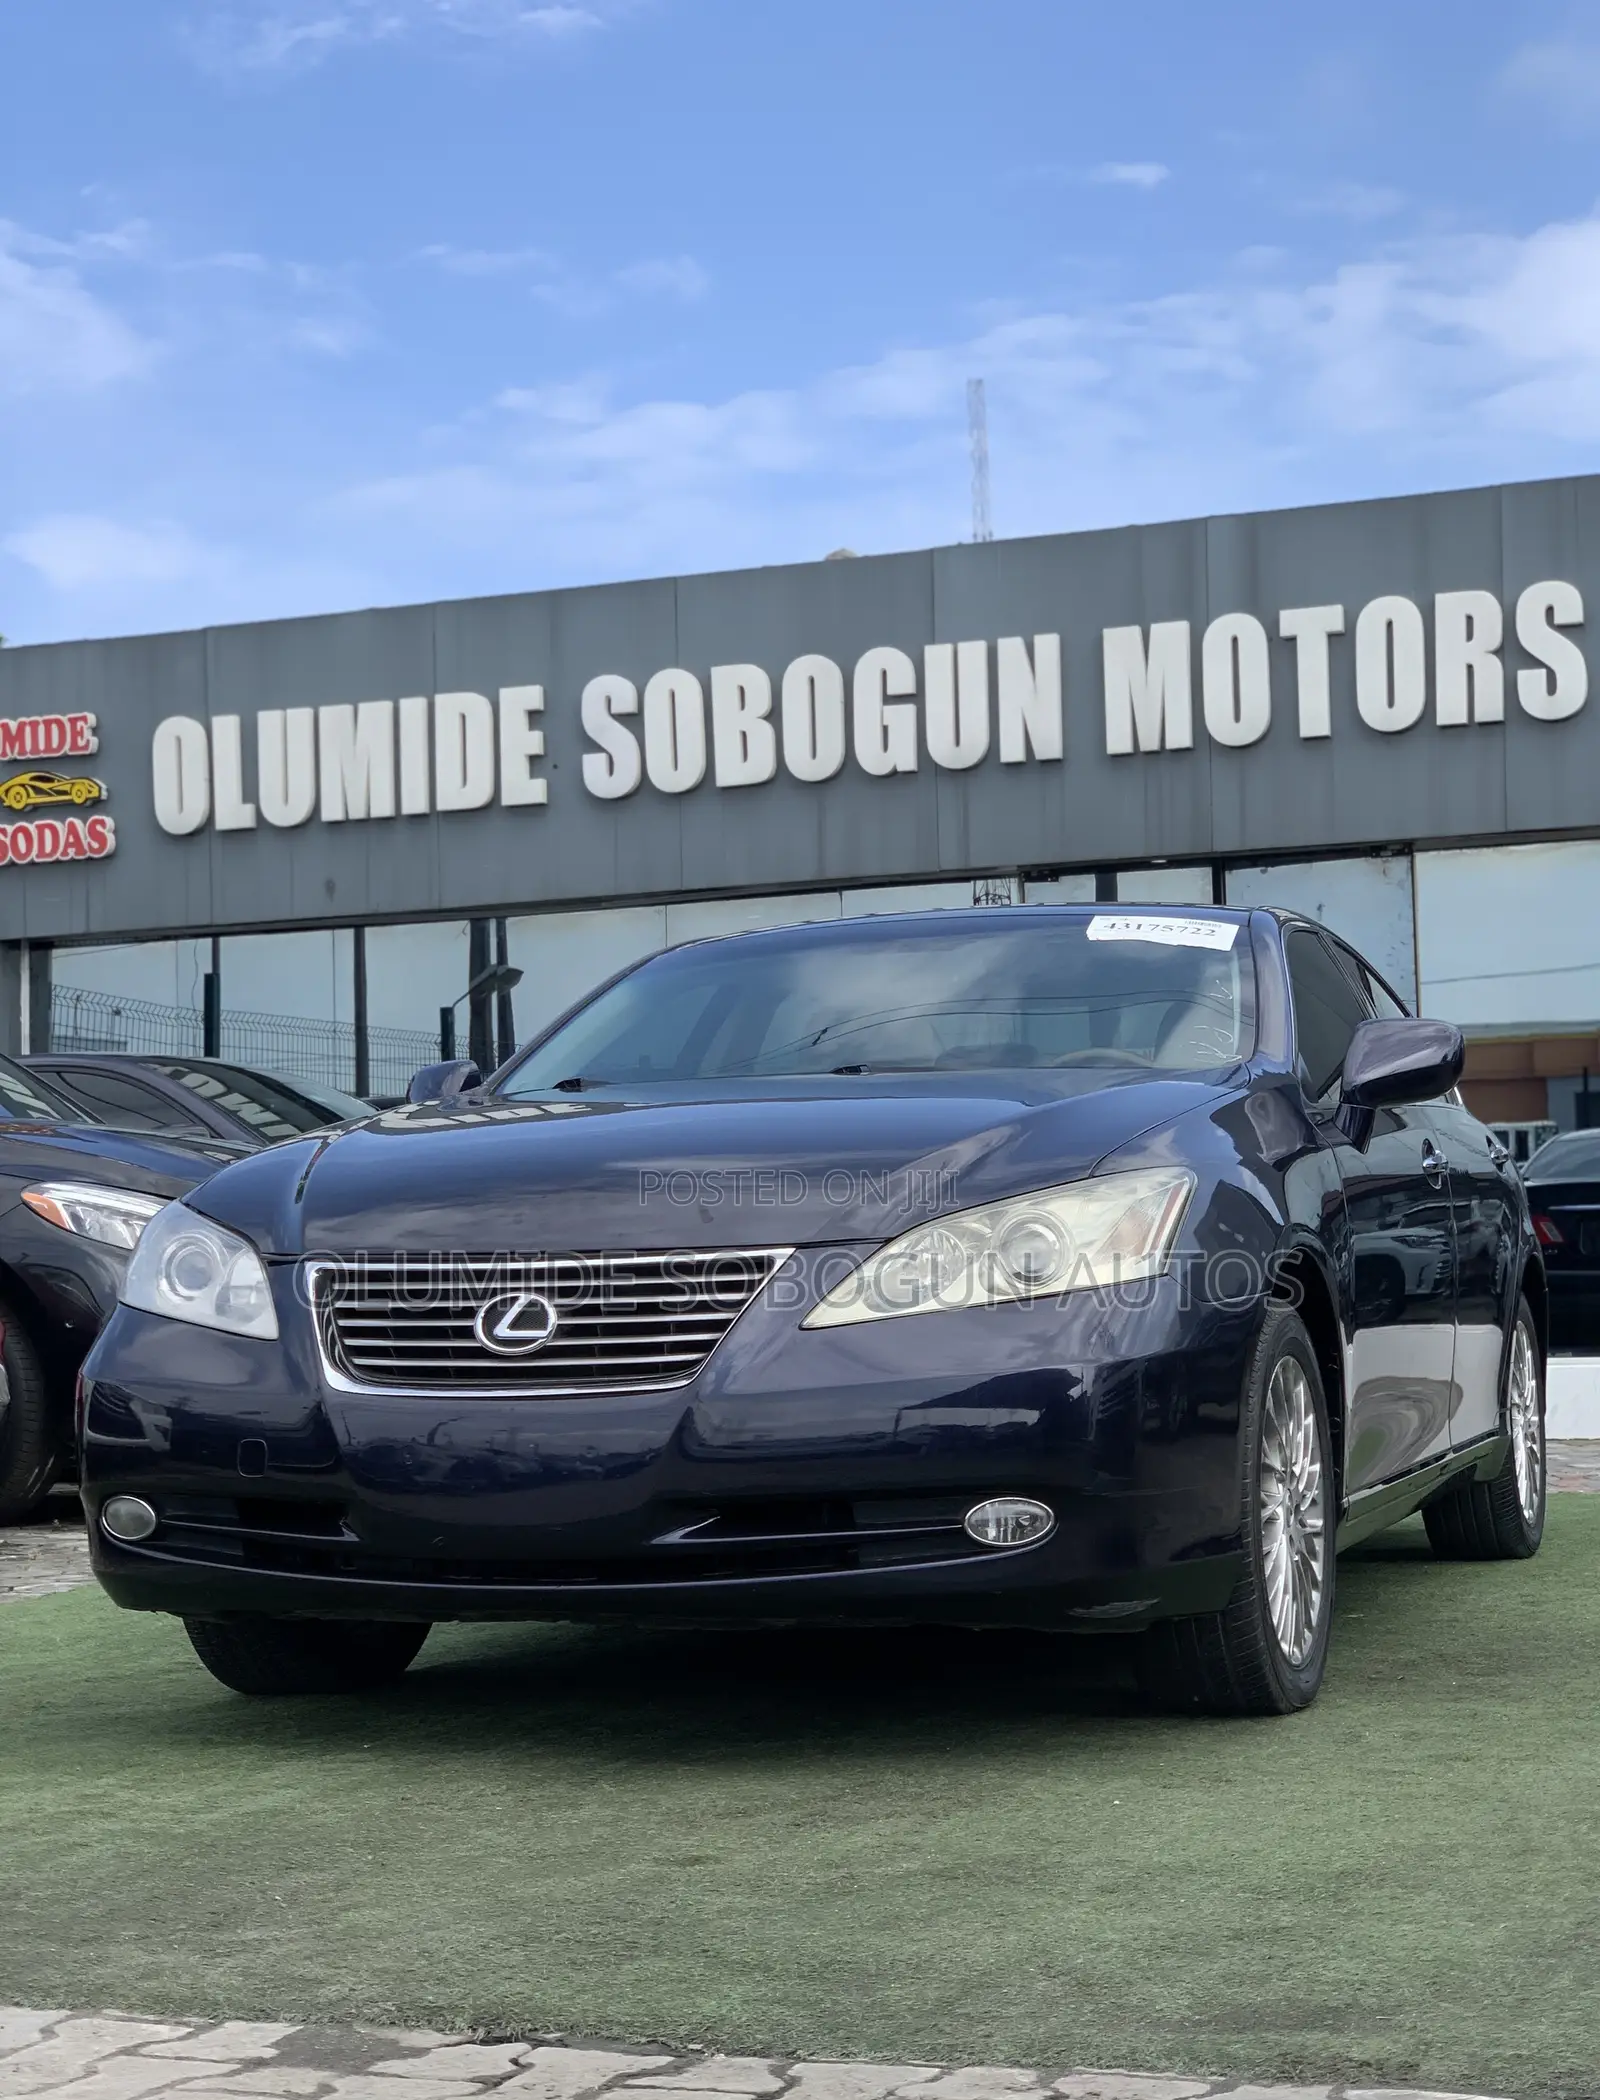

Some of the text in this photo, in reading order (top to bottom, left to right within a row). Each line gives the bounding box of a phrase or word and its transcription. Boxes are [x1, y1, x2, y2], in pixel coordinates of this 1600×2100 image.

[152, 580, 1589, 836] OLUMIDE SOBOGUN MOTORS
[1103, 922, 1217, 937] 43175722
